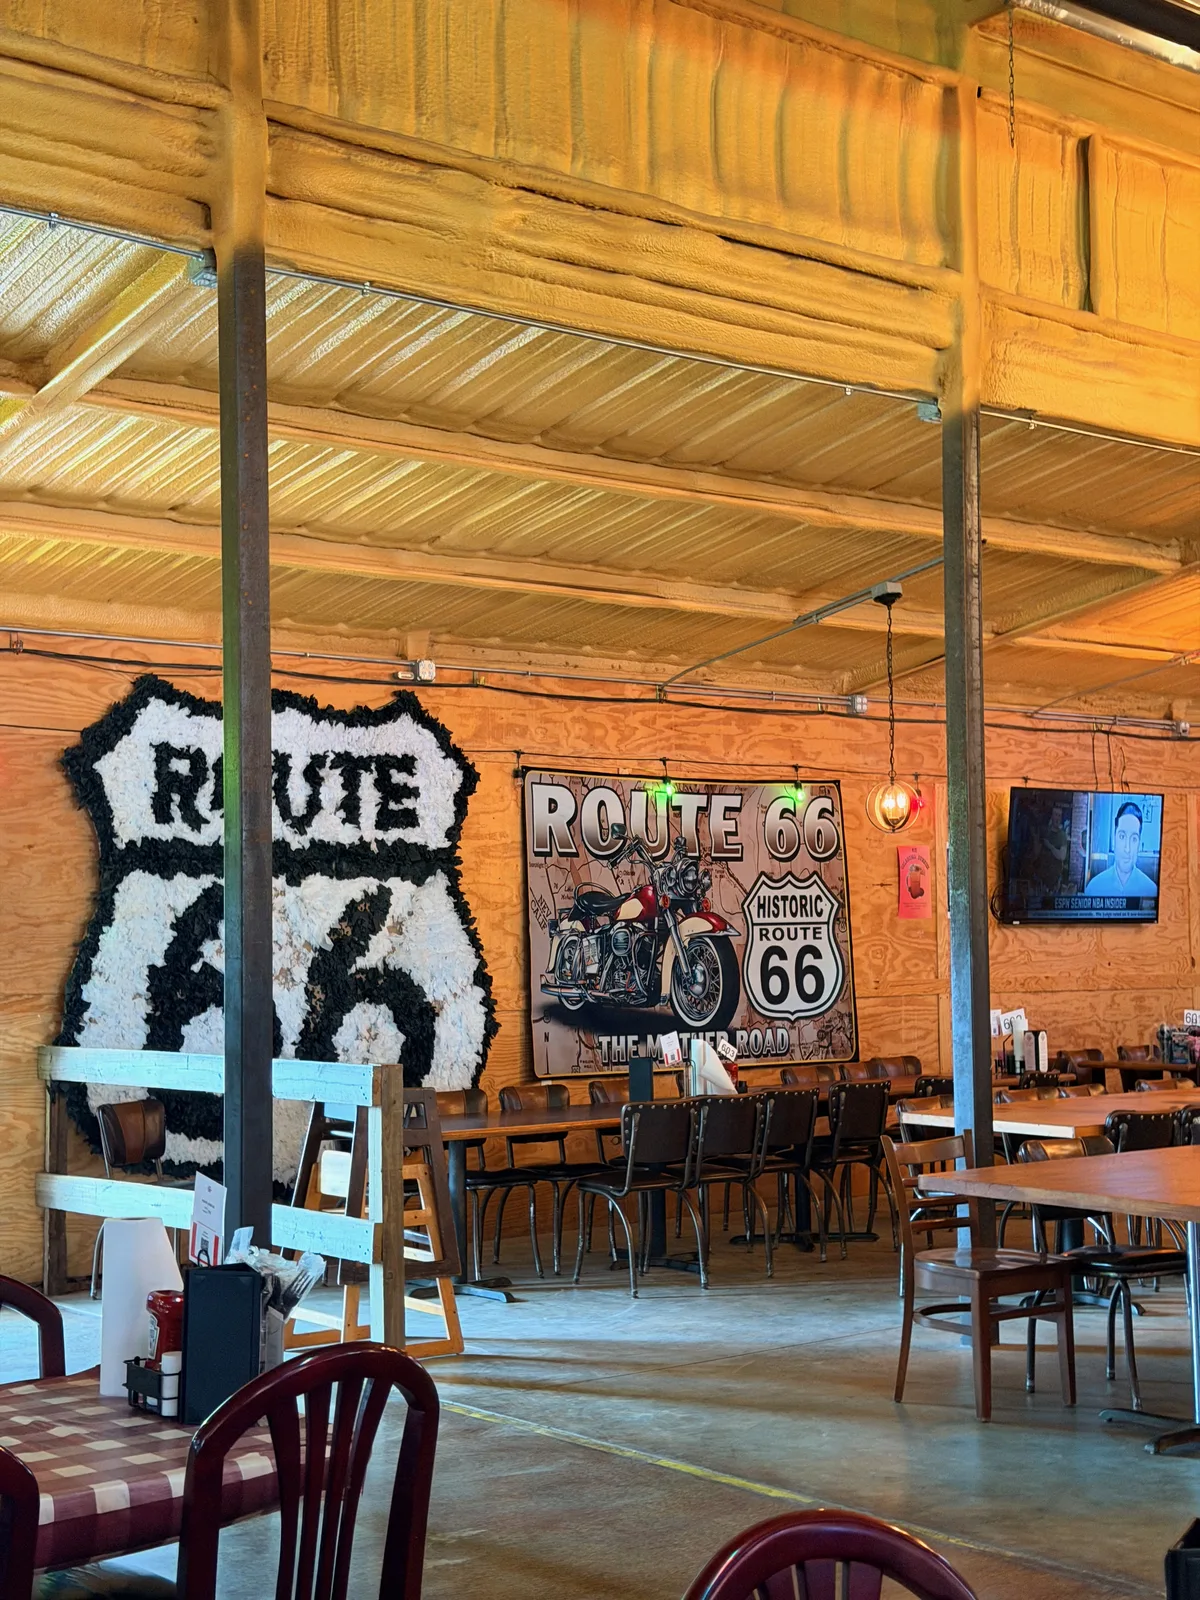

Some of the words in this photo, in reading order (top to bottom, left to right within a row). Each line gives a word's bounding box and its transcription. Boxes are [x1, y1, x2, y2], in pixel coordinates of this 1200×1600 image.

[531, 782, 743, 860] ROUTE
[764, 796, 841, 863] 66
[757, 895, 823, 918] HISTORIC
[1055, 898, 1070, 908] ESPN
[1071, 898, 1091, 908] SENIOR
[1092, 898, 1104, 908] NBA
[1105, 898, 1126, 908] INSIDER
[759, 926, 823, 941] ROUTE
[760, 944, 825, 1005] 66
[1185, 1012, 1200, 1024] 60
[598, 1035, 640, 1063] THE
[735, 1027, 790, 1056] ROAD
[721, 1042, 735, 1058] 603
